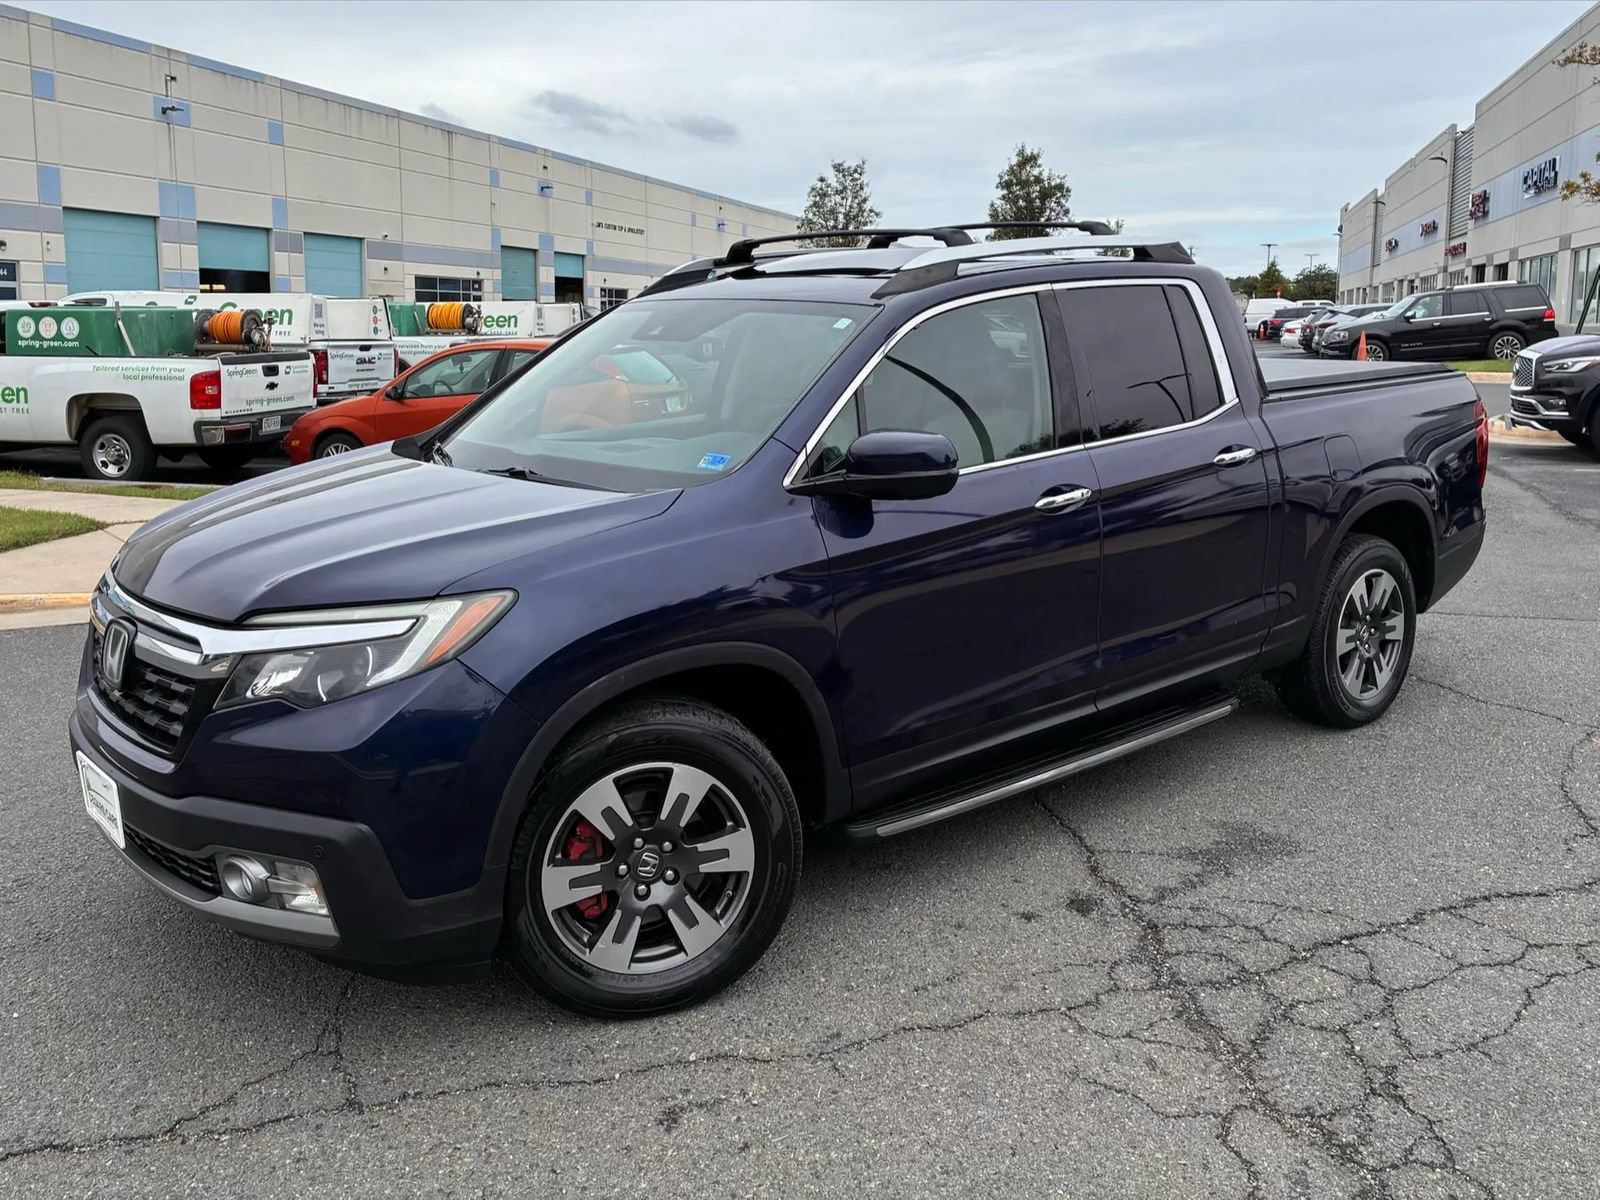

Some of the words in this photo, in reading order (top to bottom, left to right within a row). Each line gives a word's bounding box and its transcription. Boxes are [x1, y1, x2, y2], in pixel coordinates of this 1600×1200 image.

[18, 339, 80, 349] spring-green.com
[356, 356, 376, 365] GMC
[168, 366, 186, 374] your
[140, 374, 185, 382] professional
[245, 395, 296, 407] spring-green.com
